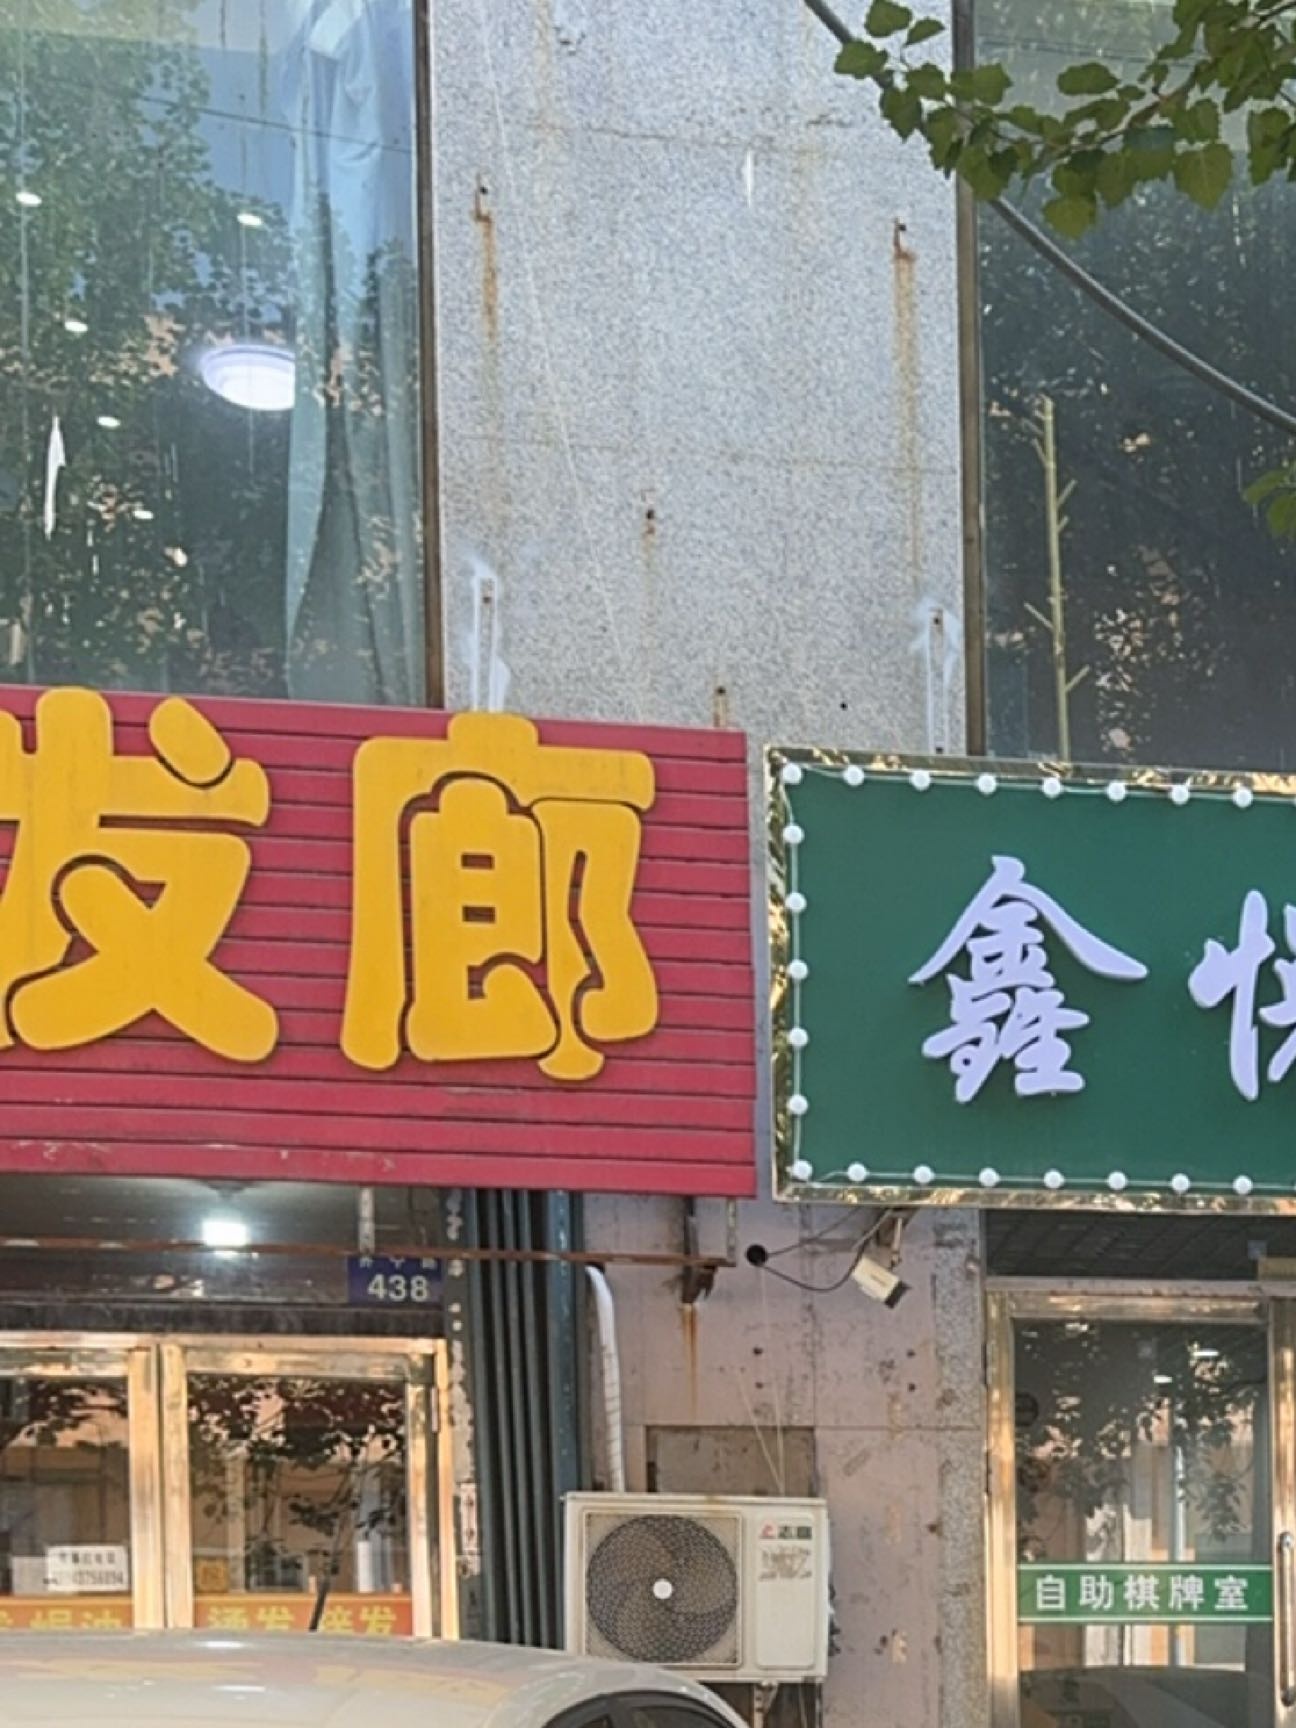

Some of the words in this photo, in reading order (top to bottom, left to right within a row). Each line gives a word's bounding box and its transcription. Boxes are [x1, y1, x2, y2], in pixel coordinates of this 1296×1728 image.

[0, 686, 660, 1080] 发廊
[367, 1273, 429, 1302] 438
[1036, 1574, 1248, 1611] 自助棋牌室
